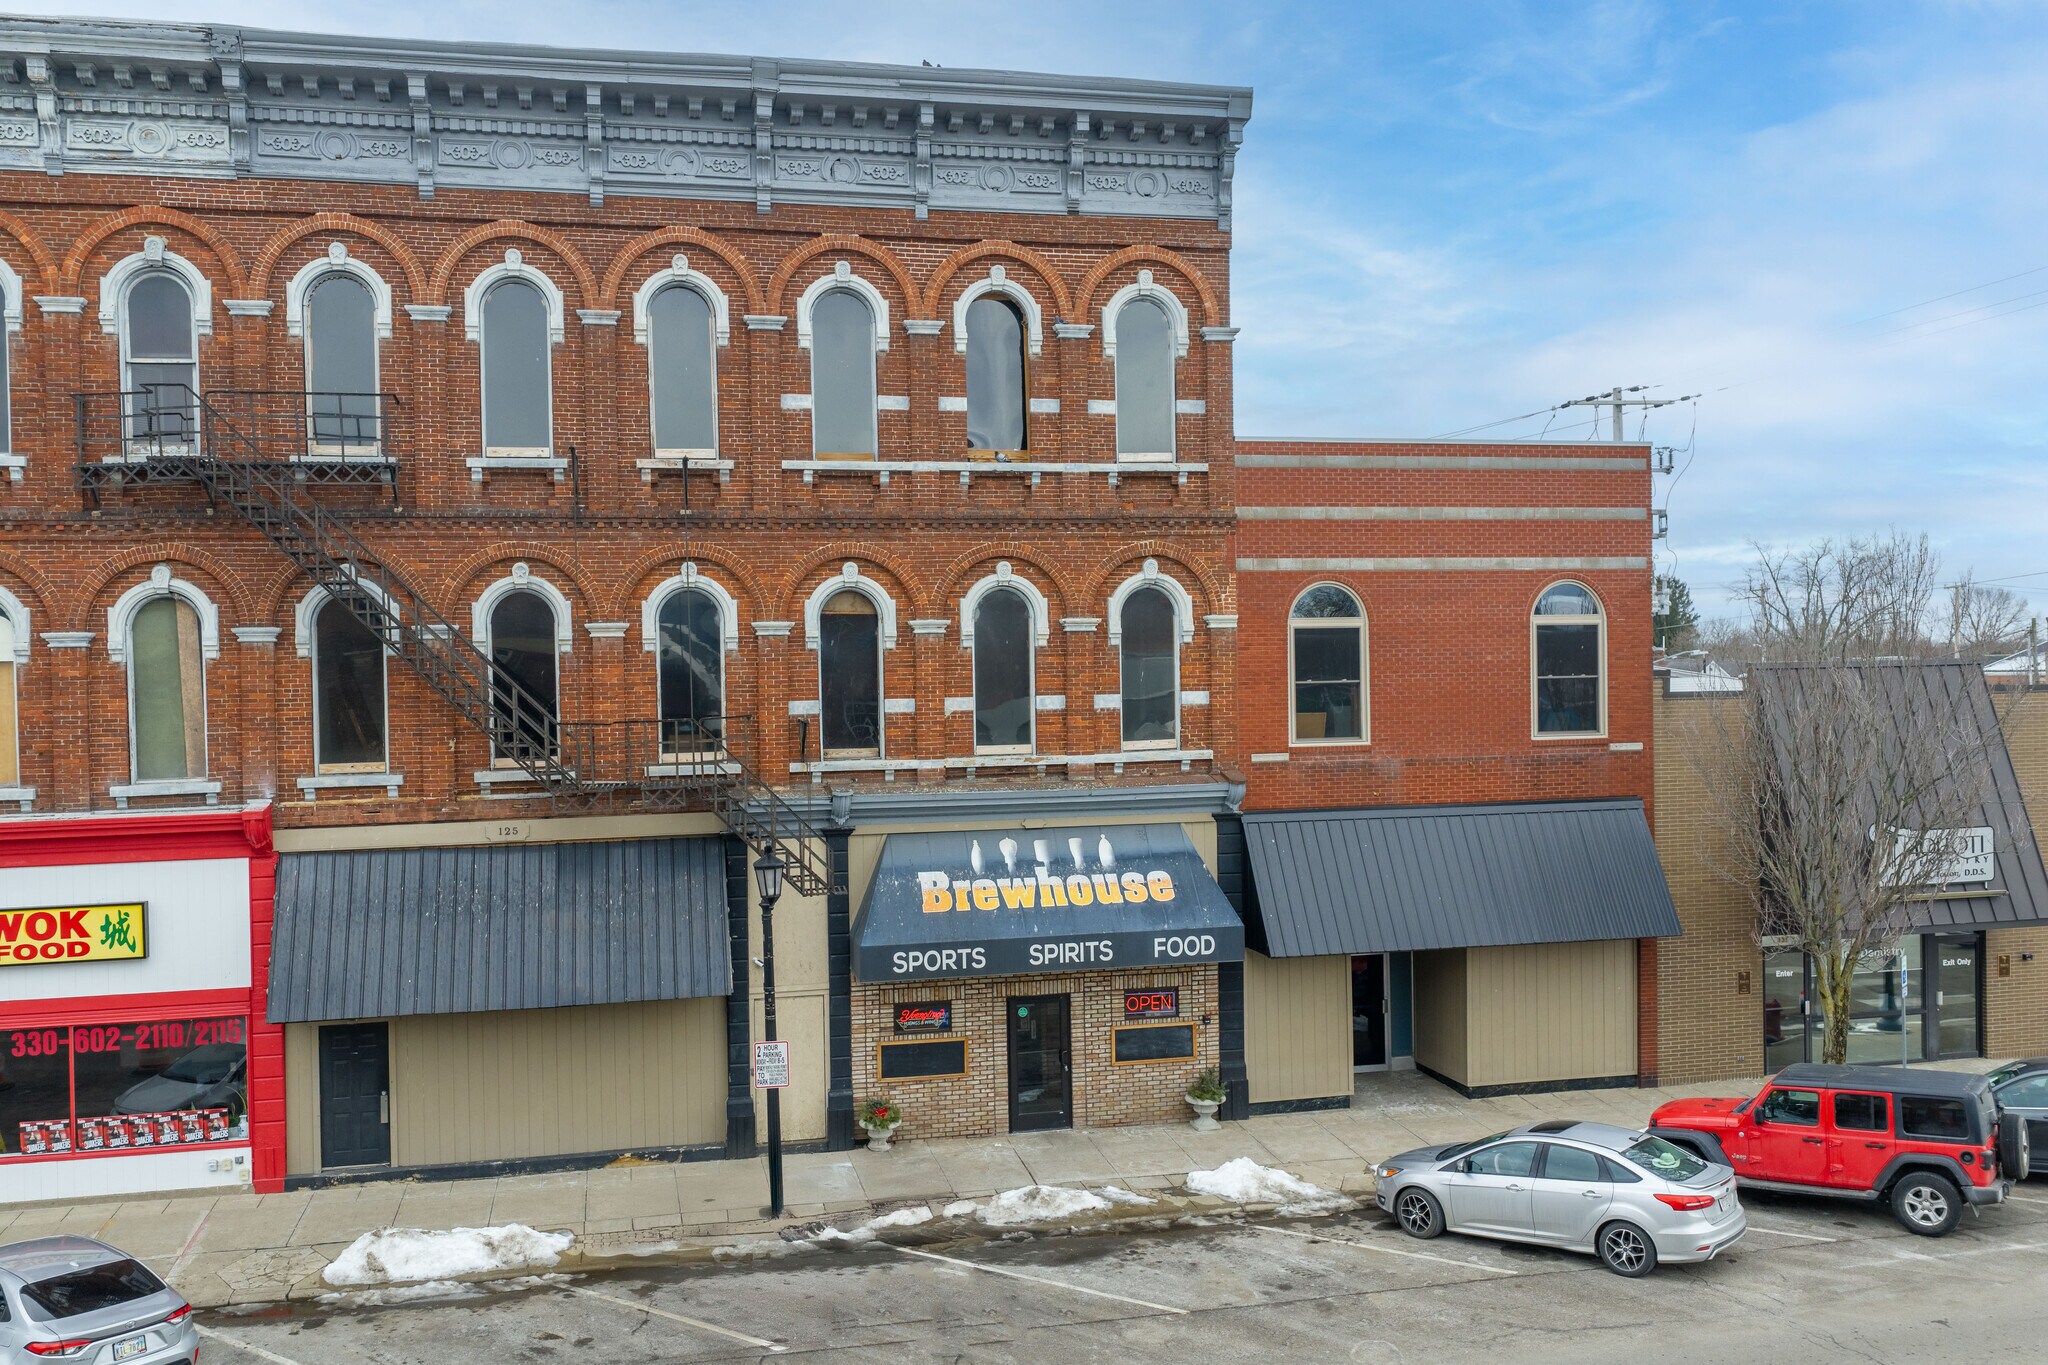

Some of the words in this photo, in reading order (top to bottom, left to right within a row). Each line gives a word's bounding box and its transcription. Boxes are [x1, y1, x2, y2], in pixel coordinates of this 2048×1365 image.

[498, 826, 519, 835] 125
[1964, 868, 1987, 877] D.D.S.
[918, 866, 1176, 913] Brewhouse
[0, 910, 91, 942] WOK
[100, 910, 136, 953] 城
[893, 947, 987, 974] SPORTS
[1029, 940, 1114, 965] SPIRITS
[1154, 935, 1215, 958] FOOD
[1957, 958, 1971, 966] Only
[1126, 995, 1171, 1011] OPEN
[757, 1046, 761, 1057] 2
